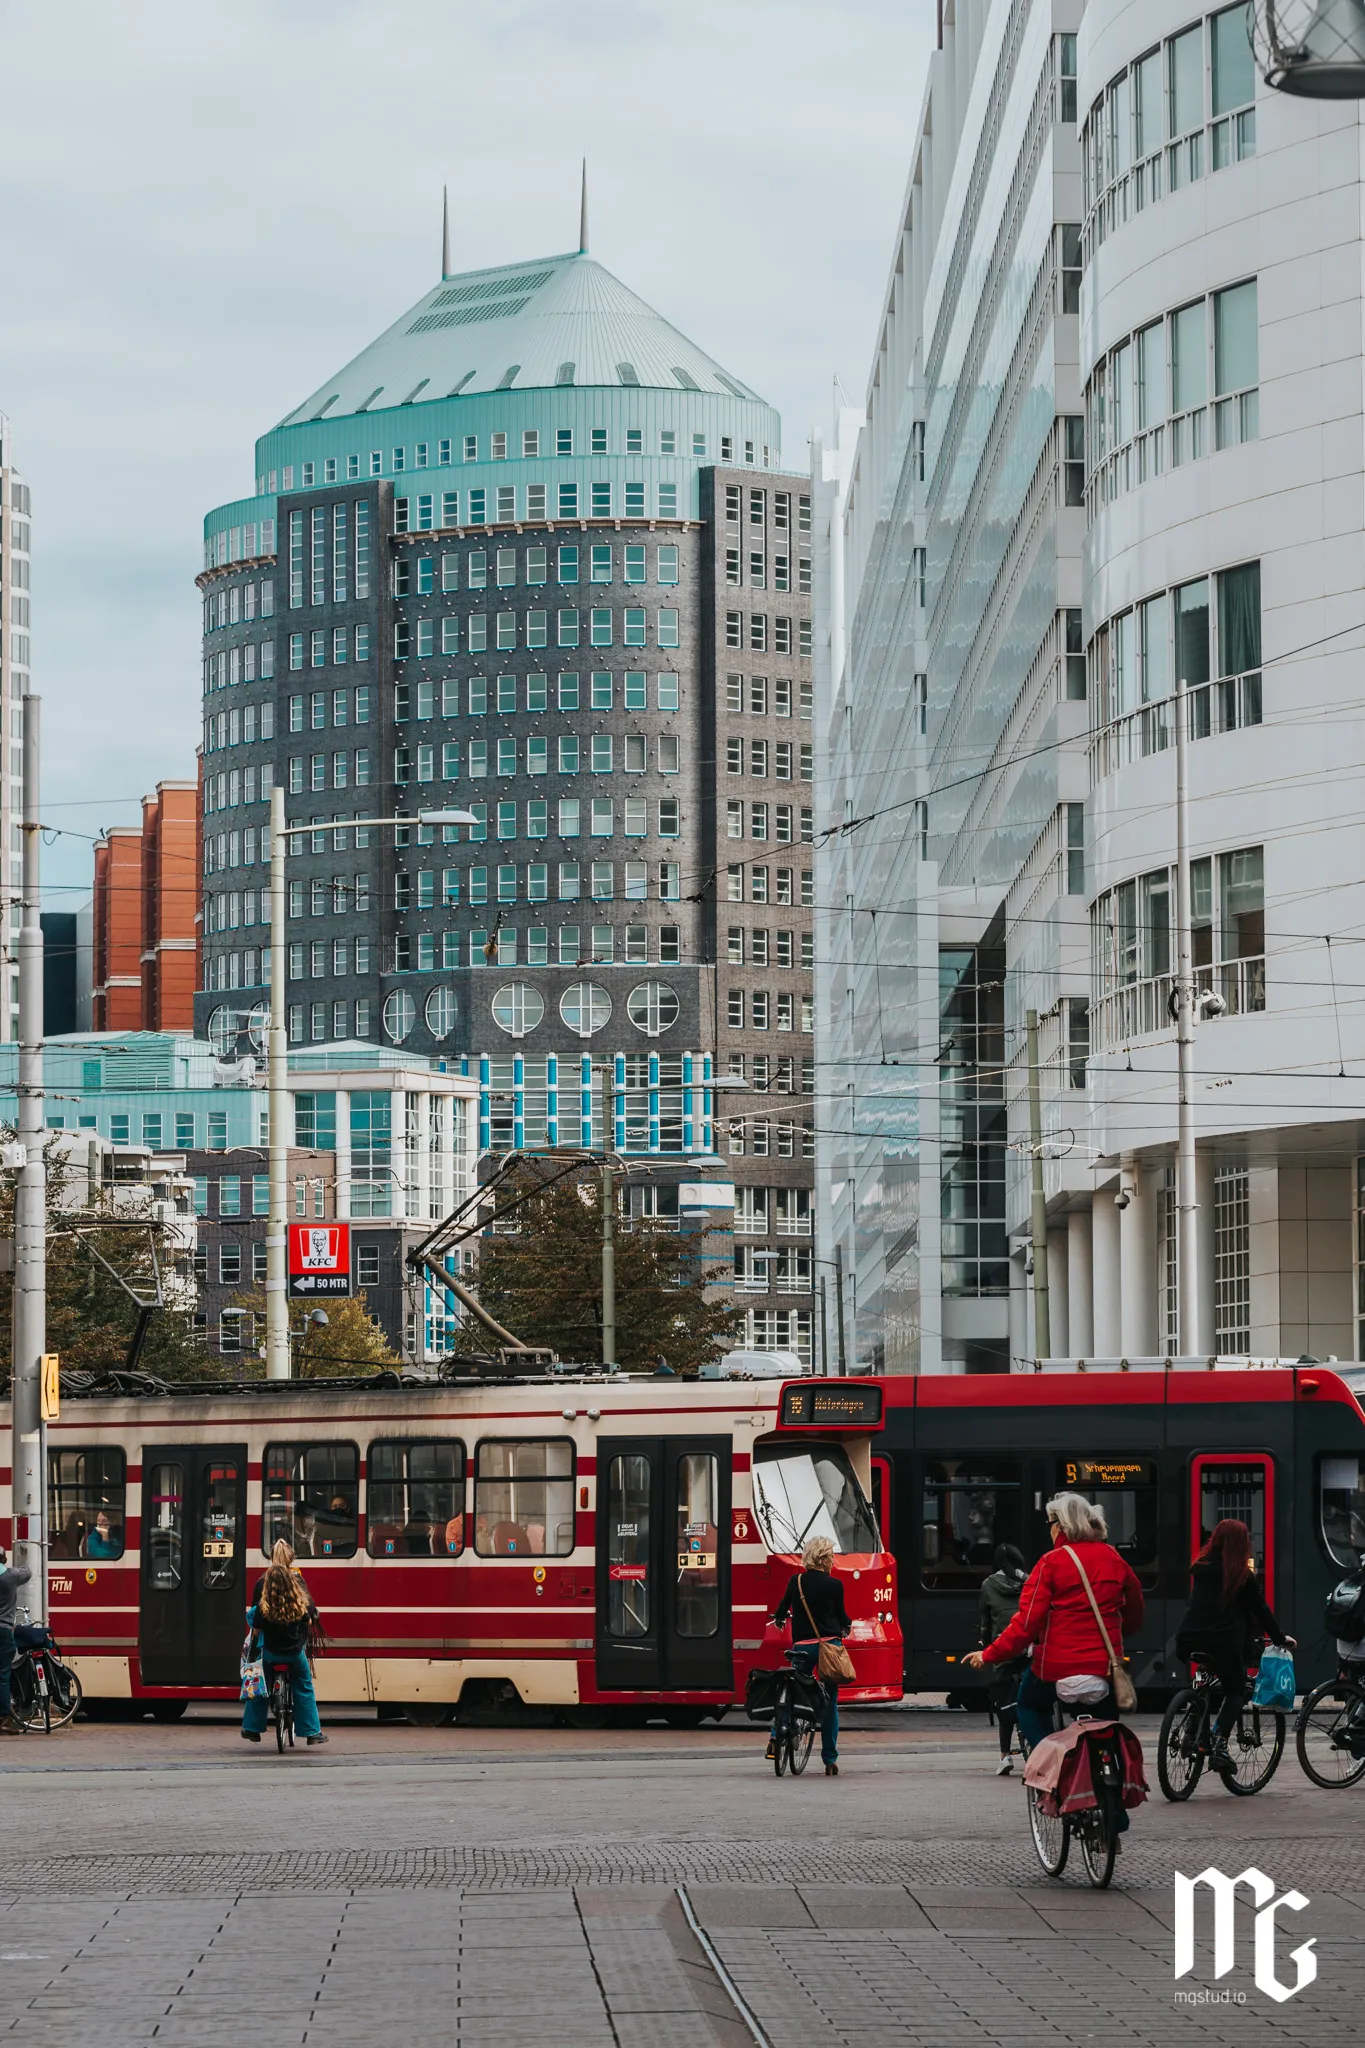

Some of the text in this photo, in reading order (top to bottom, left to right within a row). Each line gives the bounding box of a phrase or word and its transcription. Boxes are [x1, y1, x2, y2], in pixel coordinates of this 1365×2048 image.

[308, 1257, 332, 1266] KFC
[317, 1278, 348, 1288] 50 MTR
[1065, 1463, 1077, 1484] 9
[51, 1580, 73, 1591] HTM
[874, 1588, 893, 1602] 3147
